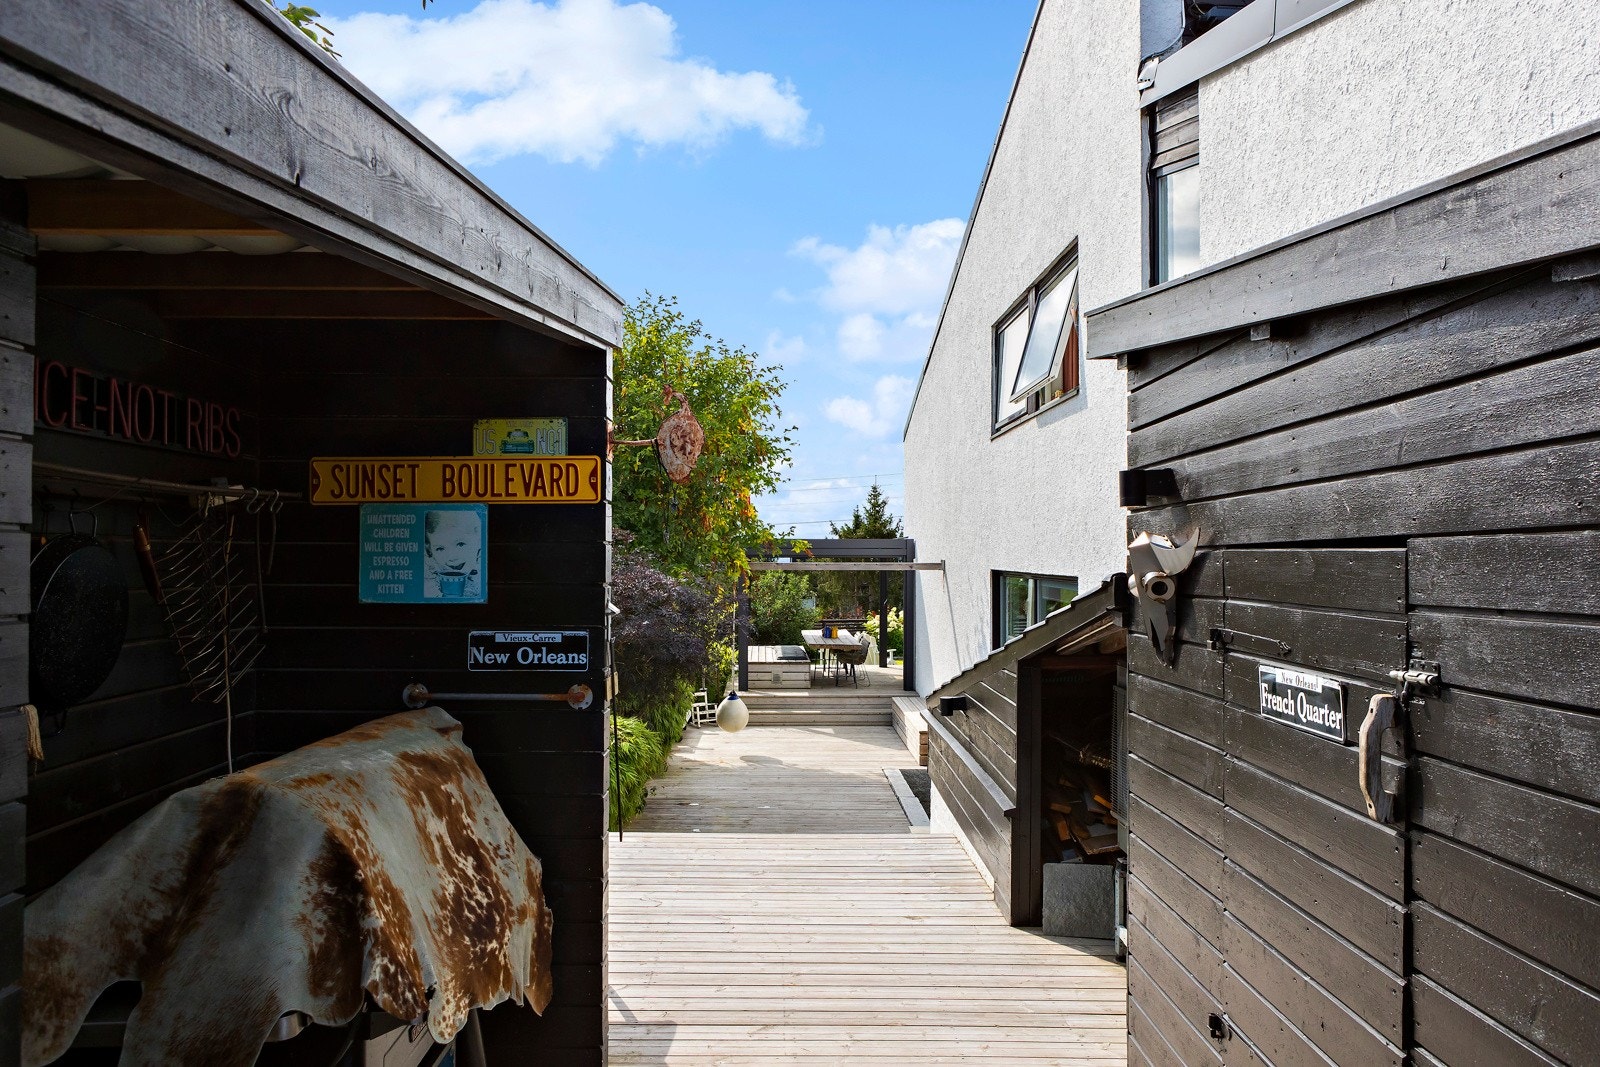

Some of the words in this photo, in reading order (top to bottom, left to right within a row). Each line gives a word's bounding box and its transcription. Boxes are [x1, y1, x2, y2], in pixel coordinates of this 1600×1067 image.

[186, 397, 241, 460] RIBS
[331, 463, 421, 499] SUNSET
[442, 462, 580, 498] BOULEVARD
[367, 514, 417, 525] UNATTENDED
[373, 528, 410, 538] CHILDREN
[364, 542, 382, 552] WILL
[384, 542, 394, 552] BE
[395, 542, 419, 552] GIVEN
[373, 556, 409, 566] ESPRESSO
[369, 570, 385, 580] AND
[387, 570, 394, 580] A
[395, 570, 413, 580] FREE
[378, 584, 404, 594] KITTEN
[469, 646, 511, 664] New
[516, 646, 587, 665] Orleans
[1281, 672, 1293, 683] New
[1261, 682, 1295, 716] French
[1297, 691, 1342, 730] Quarter
